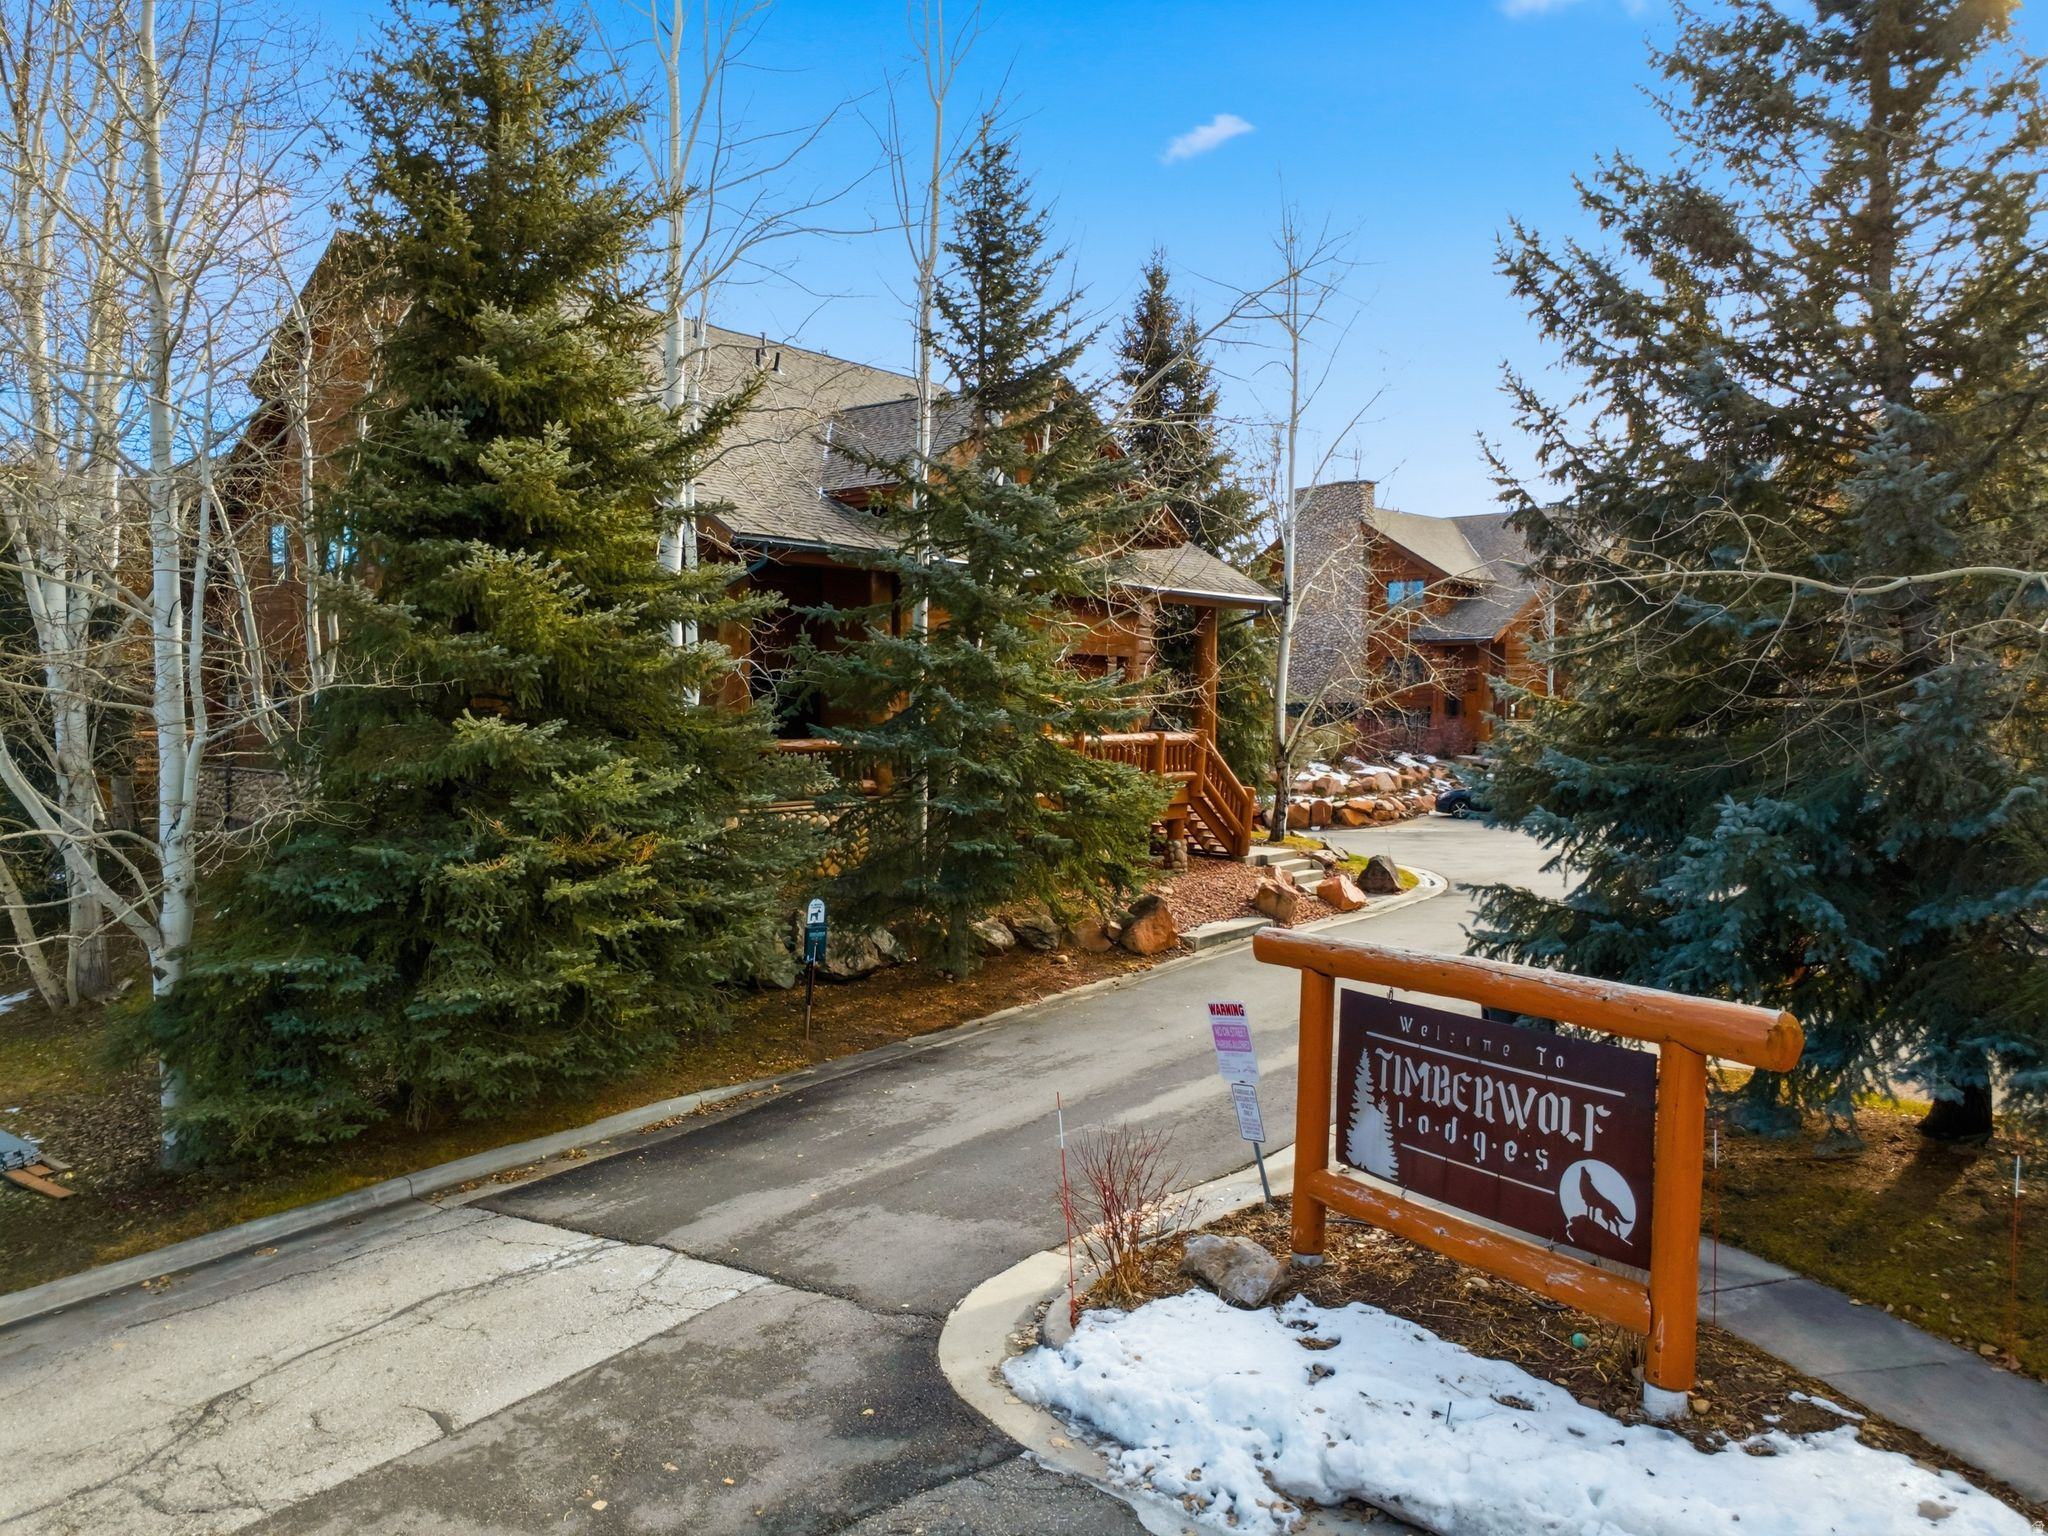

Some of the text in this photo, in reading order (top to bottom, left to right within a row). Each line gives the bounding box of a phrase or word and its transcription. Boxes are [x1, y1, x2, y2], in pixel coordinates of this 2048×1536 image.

[1208, 1003, 1245, 1016] WARNING
[1399, 1015, 1564, 1069] Welcome To
[1374, 1047, 1611, 1152] TIMBERWOLF
